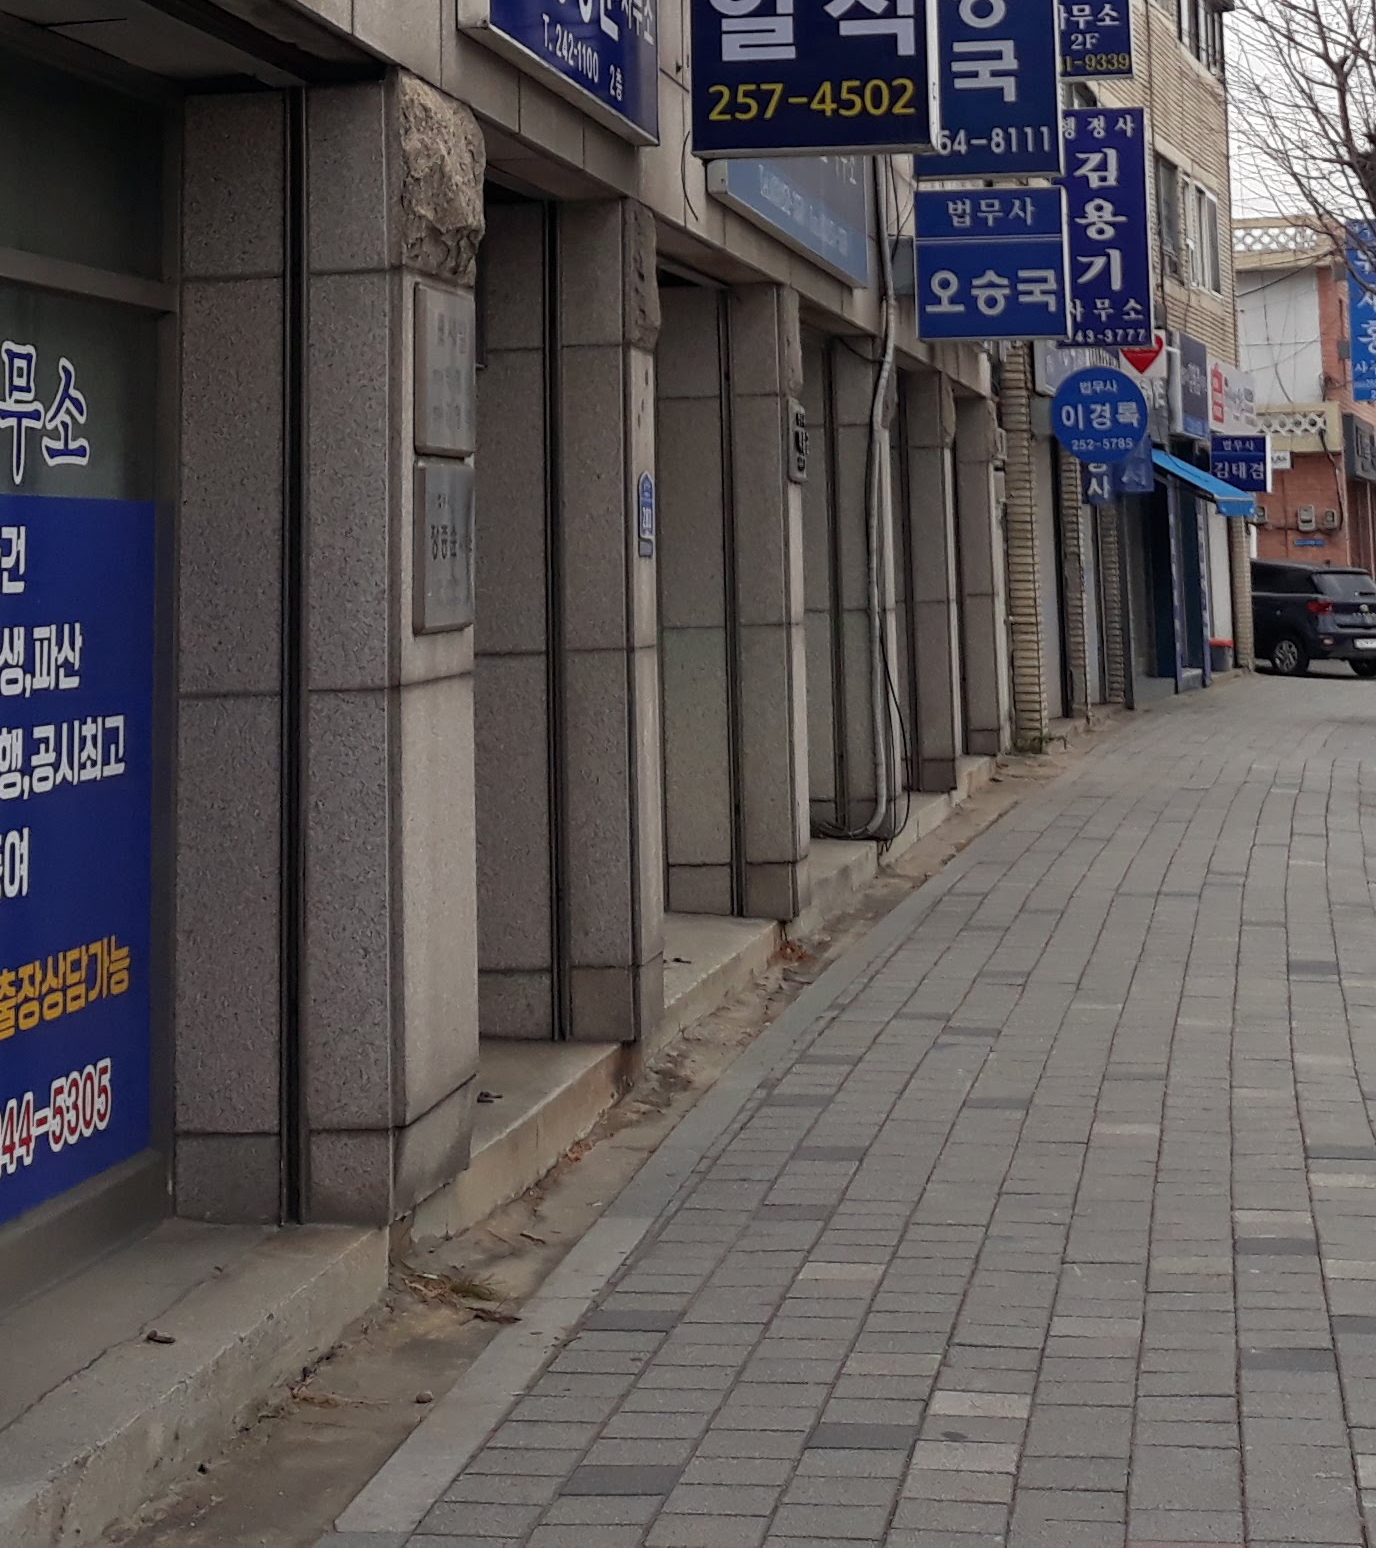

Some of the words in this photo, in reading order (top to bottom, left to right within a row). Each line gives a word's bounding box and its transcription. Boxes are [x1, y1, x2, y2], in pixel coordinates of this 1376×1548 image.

[1070, 32, 1101, 50] 2F
[555, 23, 600, 84] 242-1100
[609, 64, 624, 102] 2층
[707, 78, 918, 122] 257-4502
[946, 196, 1036, 228] 법무사
[1072, 146, 1129, 292] 김용기
[926, 268, 1057, 317] 오승국
[1078, 378, 1119, 395] 법무사
[1061, 401, 1141, 431] 이경록
[1071, 437, 1135, 451] 252-5785
[1221, 438, 1257, 452] 법무사
[1213, 460, 1265, 480] 김태겸
